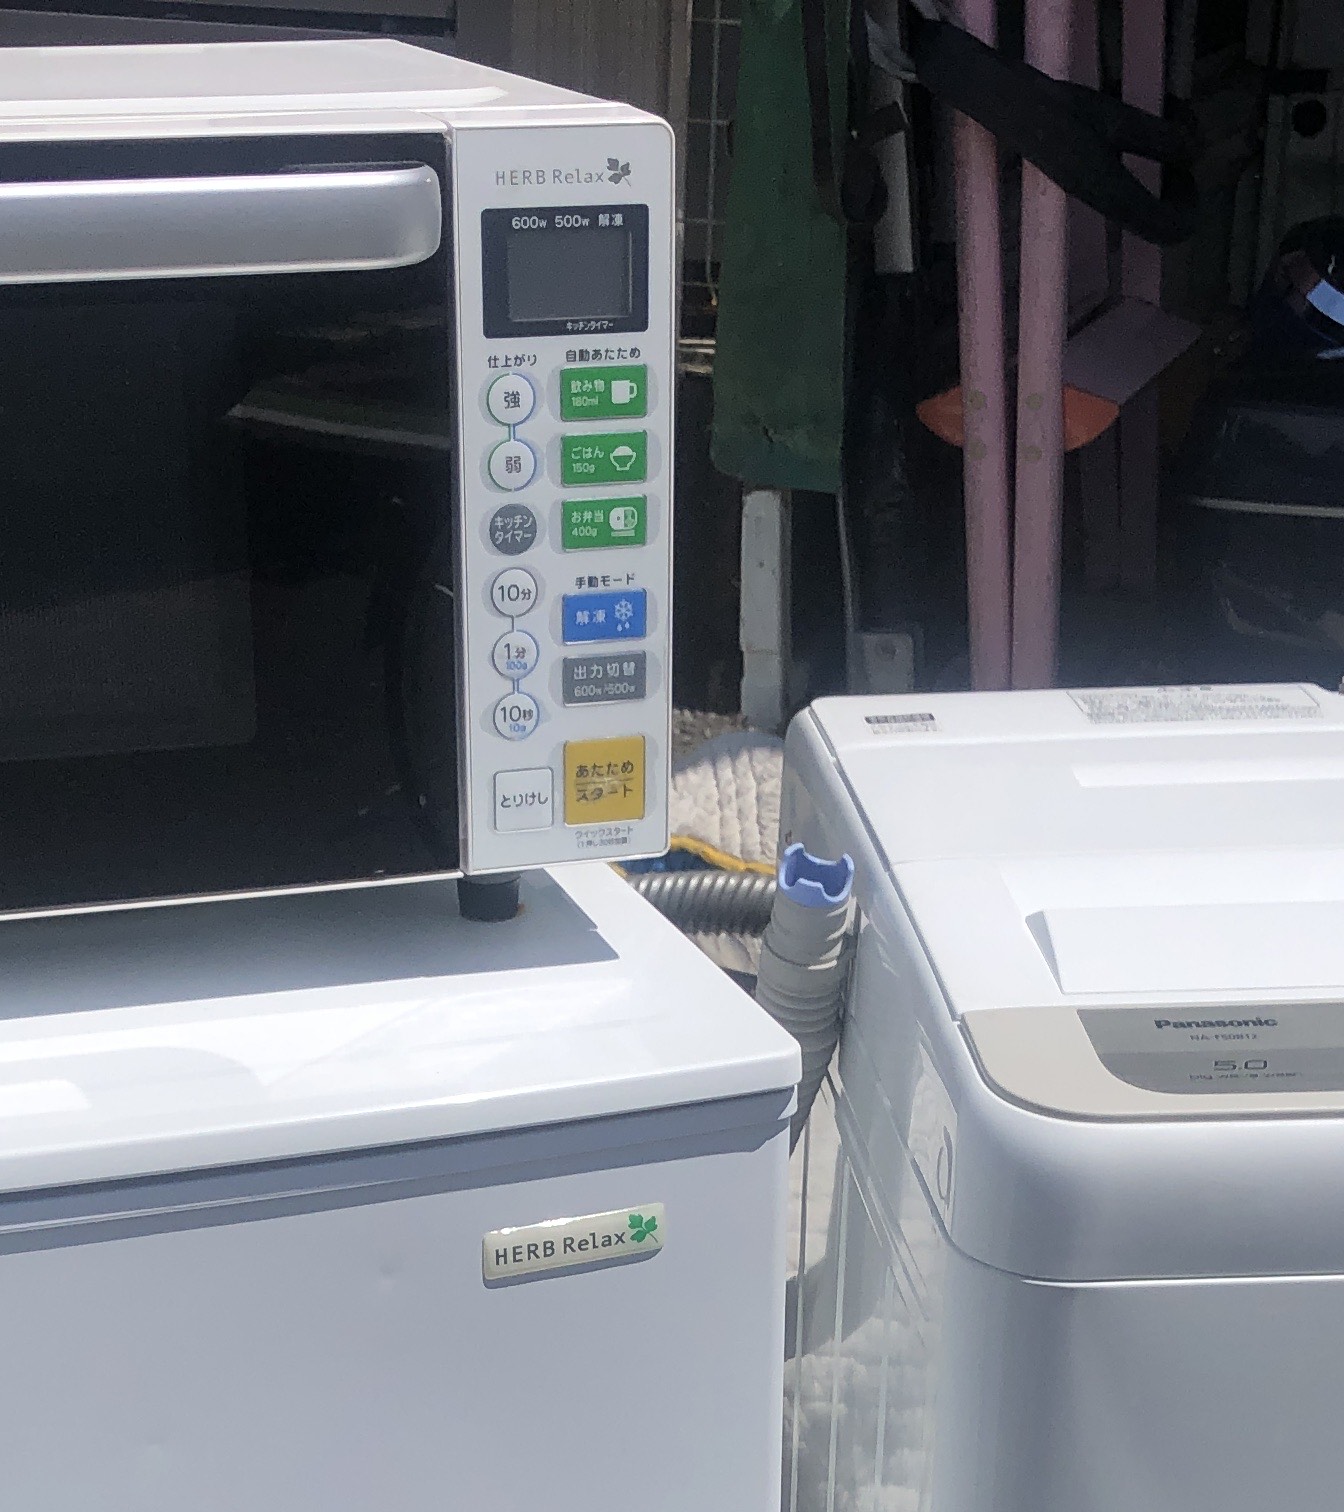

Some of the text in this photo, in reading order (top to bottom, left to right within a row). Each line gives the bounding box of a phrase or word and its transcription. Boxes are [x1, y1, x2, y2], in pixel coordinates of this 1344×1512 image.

[495, 168, 604, 186] HERB Relax
[566, 320, 614, 331] キッチンタイマー
[487, 354, 538, 369] 仕上がり
[565, 346, 641, 362] 自動あたため
[570, 379, 605, 393] 飲み物
[503, 391, 521, 409] 強
[571, 445, 605, 460] ごはん
[505, 455, 522, 474] 弱
[494, 513, 533, 529] キッチン
[571, 509, 604, 524] お弁当
[494, 530, 533, 544] タイマー
[571, 526, 598, 538] 400g
[575, 572, 635, 590] 手動モード
[497, 584, 532, 602] 10分
[503, 643, 527, 660] 1分
[573, 661, 636, 680] 出力切替
[575, 759, 634, 778] あたため
[500, 791, 549, 809] とりけし
[576, 783, 633, 802] スタート
[1154, 1017, 1278, 1029] Panasonic
[1213, 1059, 1268, 1071] 5.0
[495, 1231, 626, 1266] HERB Relax
